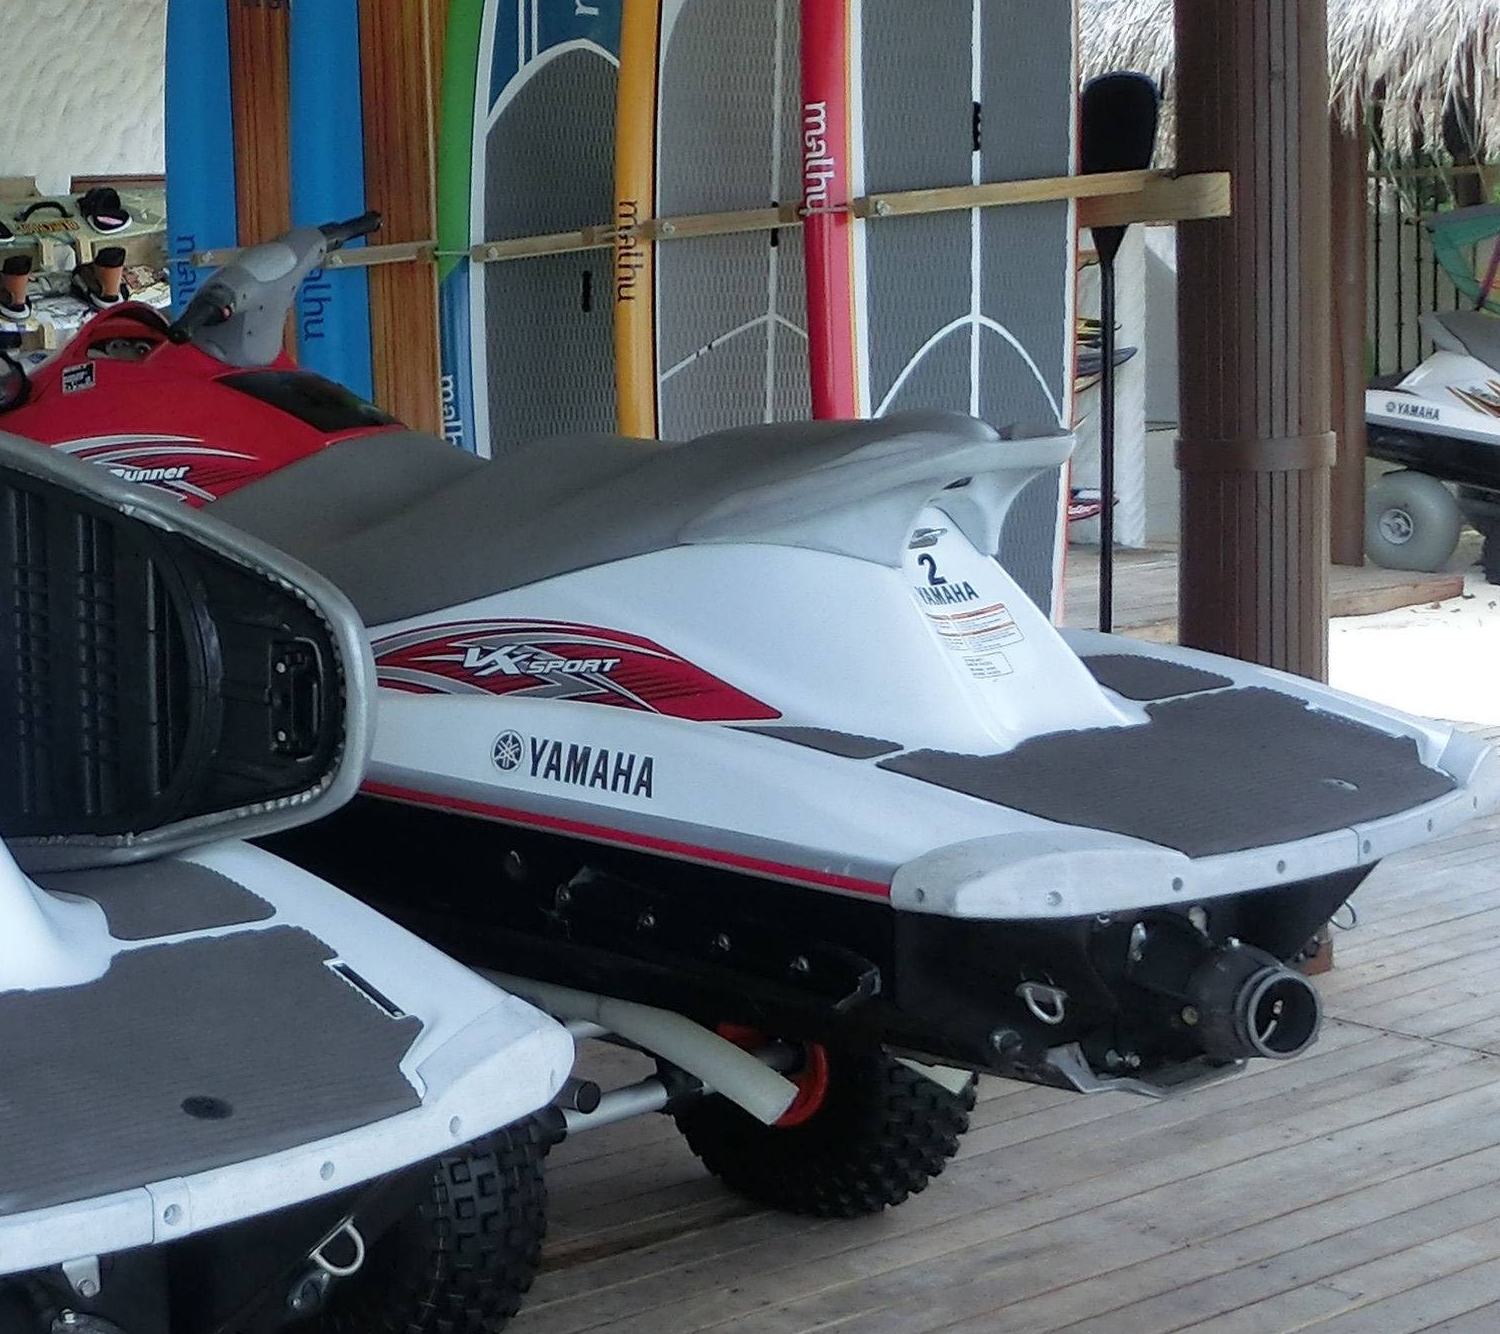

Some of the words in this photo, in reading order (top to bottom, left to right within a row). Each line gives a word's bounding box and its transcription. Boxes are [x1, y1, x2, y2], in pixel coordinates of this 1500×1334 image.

[303, 269, 331, 340] alhu
[442, 375, 463, 445] malh
[1398, 402, 1440, 421] YAMAHA
[917, 553, 948, 586] 2
[915, 581, 980, 606] YAMAHA
[463, 644, 533, 676] VX
[526, 658, 621, 674] SPORT
[529, 736, 654, 799] YAMAHA
